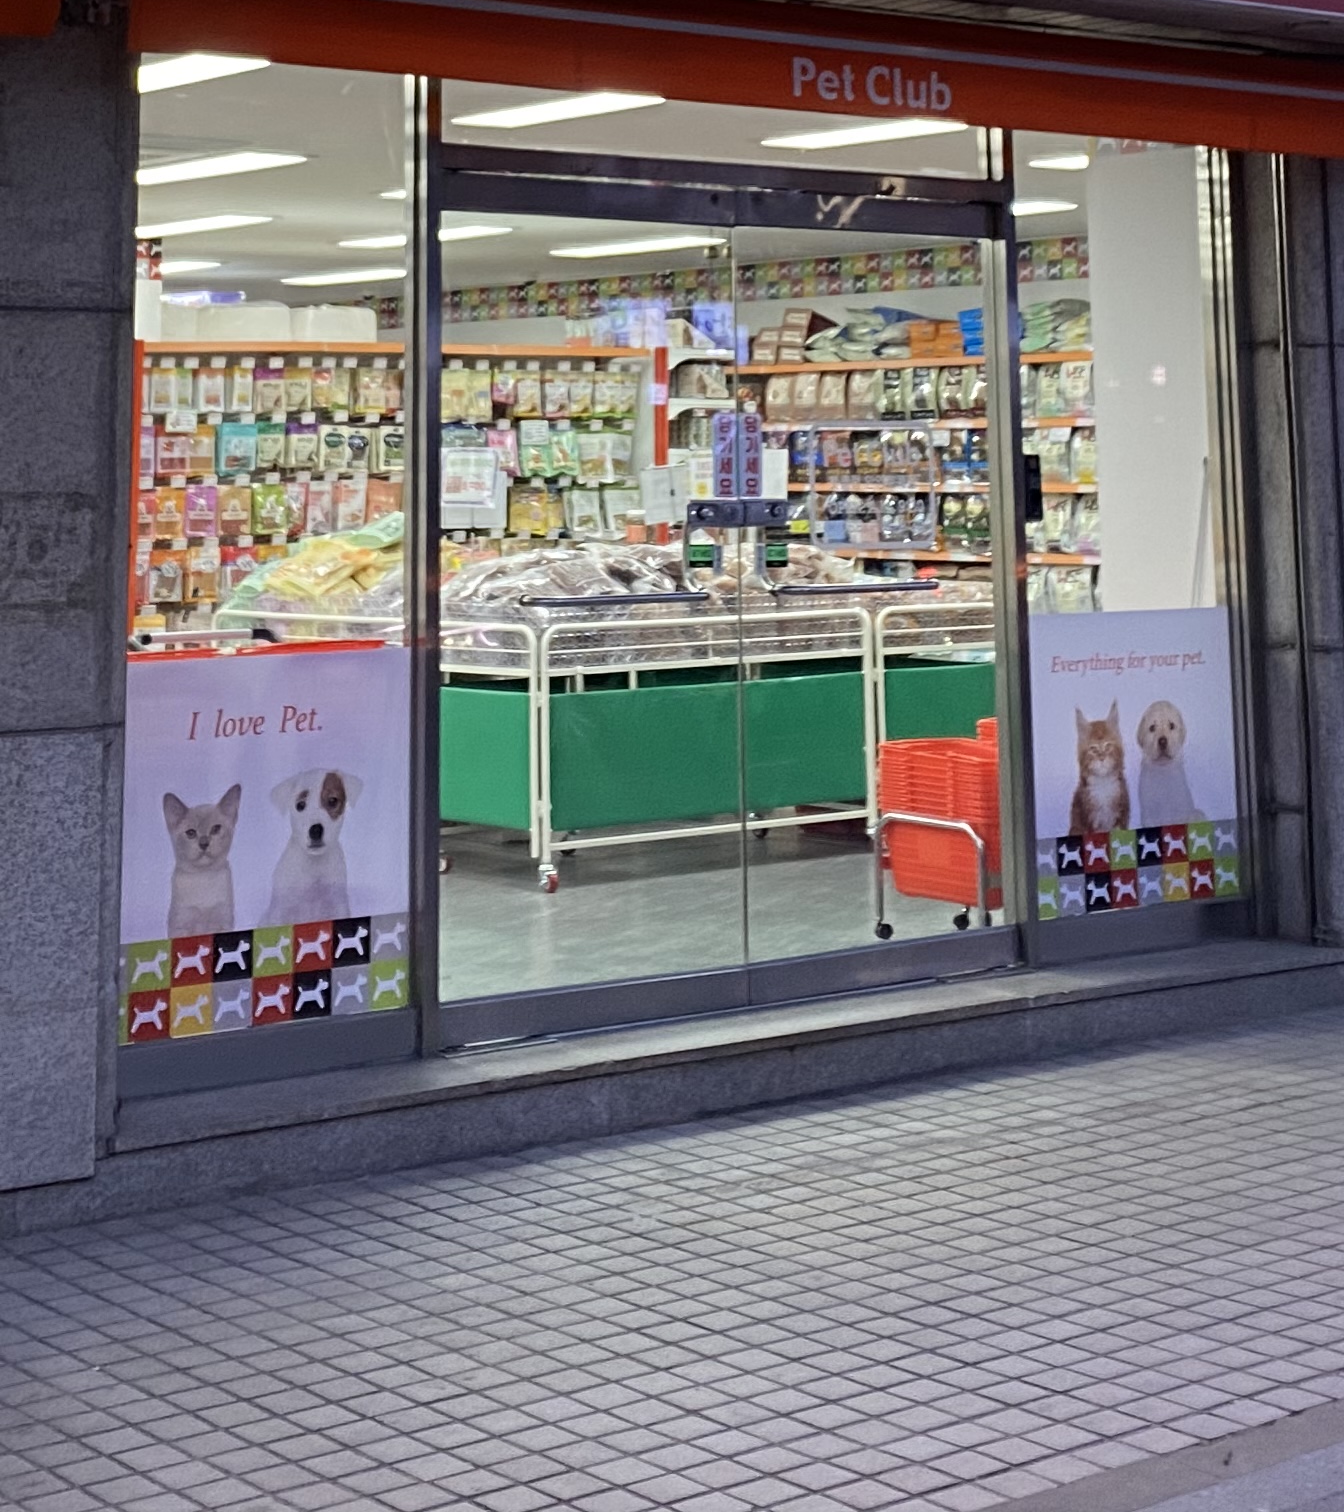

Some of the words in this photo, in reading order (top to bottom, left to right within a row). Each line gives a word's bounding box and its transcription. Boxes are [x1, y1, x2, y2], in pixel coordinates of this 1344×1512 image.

[791, 56, 855, 102] Pet
[865, 65, 953, 111] Club
[1050, 651, 1126, 676] Everything
[1127, 649, 1147, 669] for
[1148, 652, 1180, 673] your
[187, 710, 201, 741] I
[214, 708, 266, 738] love
[279, 704, 323, 733] Pet.
